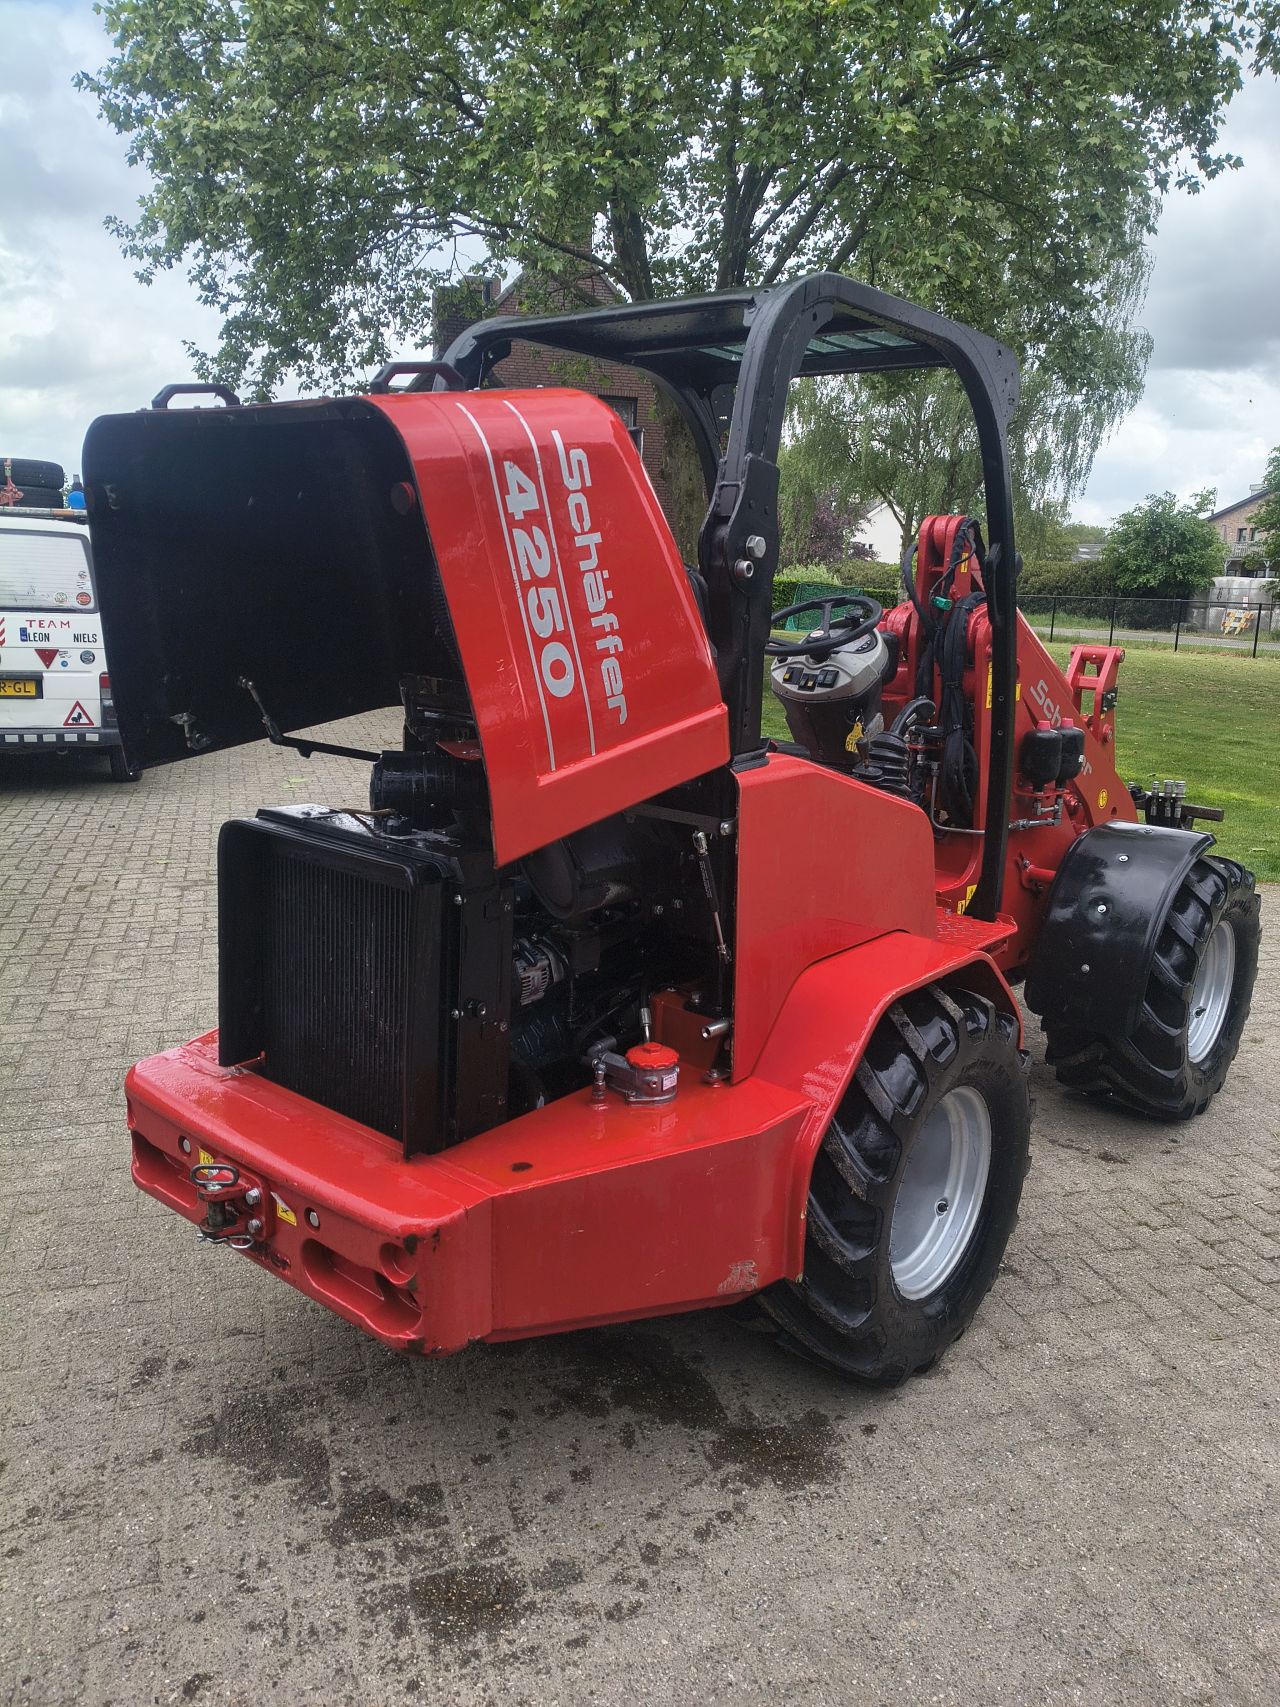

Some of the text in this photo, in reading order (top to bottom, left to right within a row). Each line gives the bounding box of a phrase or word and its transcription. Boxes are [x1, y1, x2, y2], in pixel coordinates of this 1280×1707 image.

[502, 461, 575, 698] 4250
[551, 429, 628, 725] Schäffer
[25, 619, 71, 629] TEAM
[28, 632, 97, 643] LEON NIELS
[0, 681, 31, 693] R-GL
